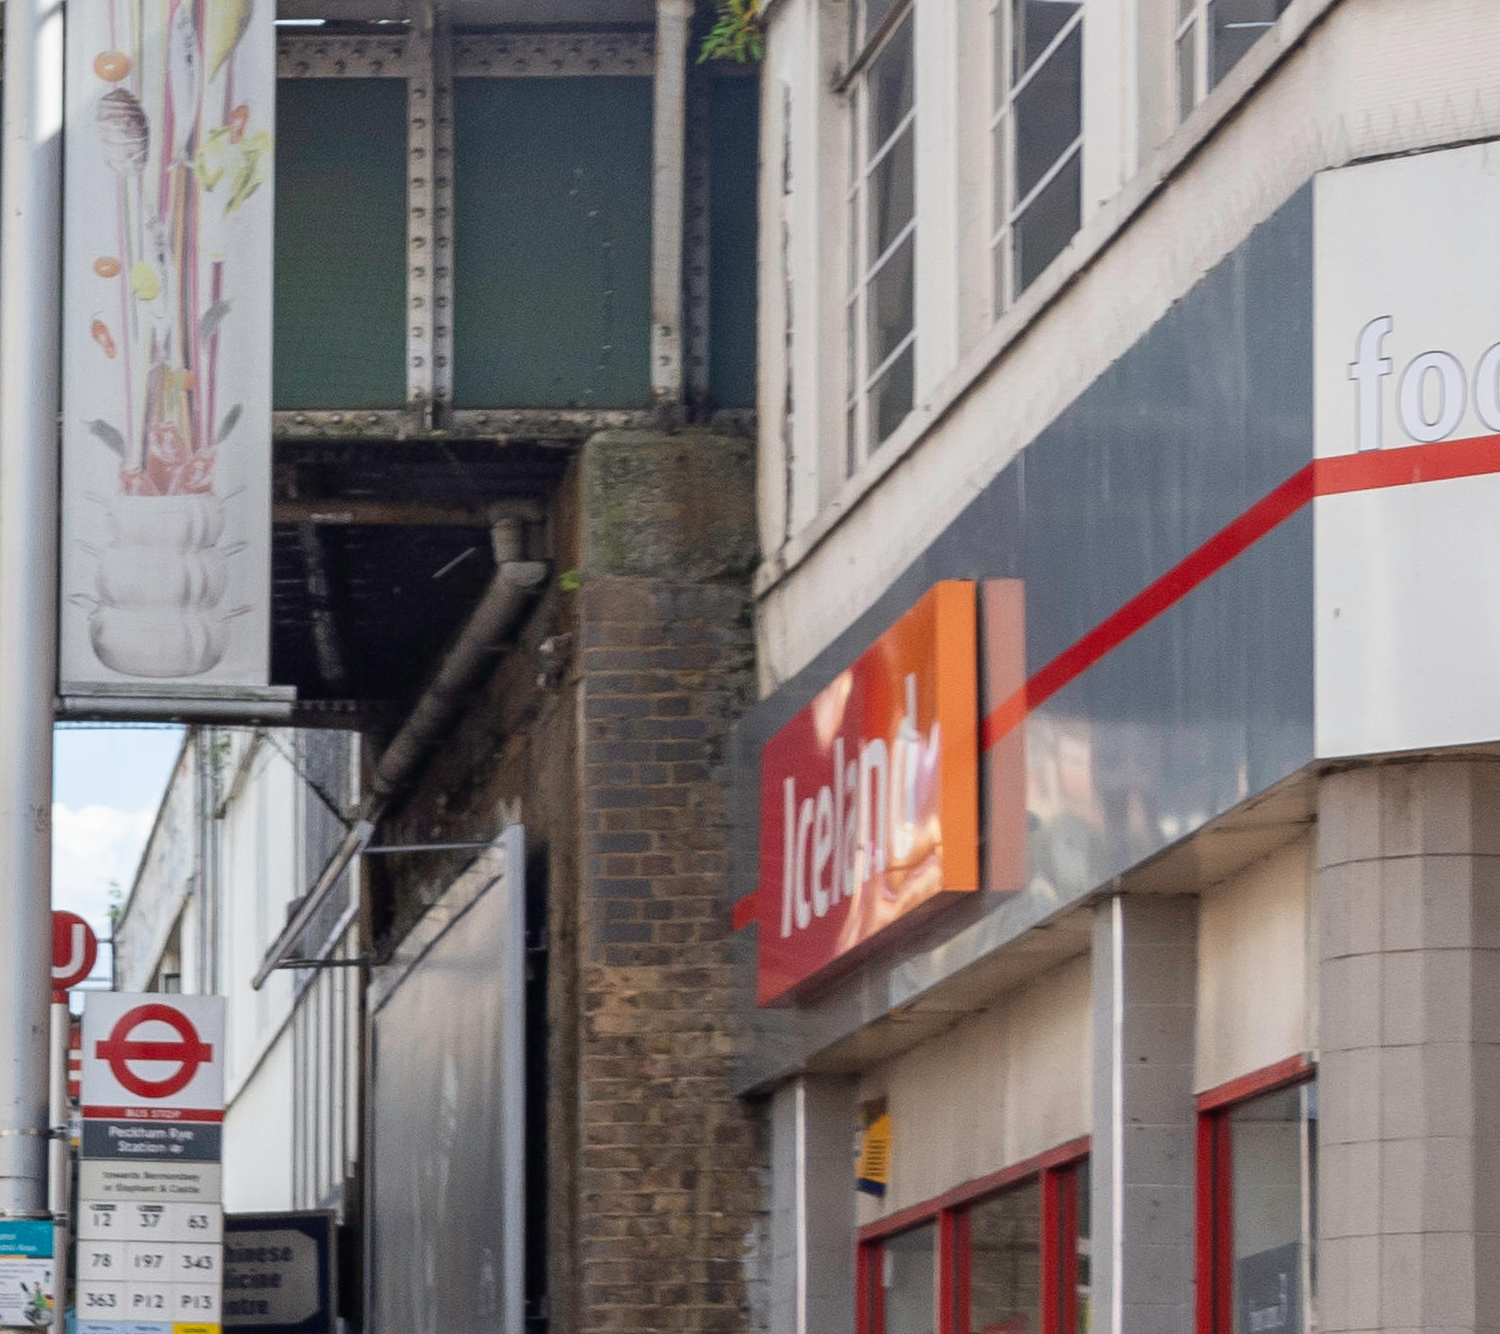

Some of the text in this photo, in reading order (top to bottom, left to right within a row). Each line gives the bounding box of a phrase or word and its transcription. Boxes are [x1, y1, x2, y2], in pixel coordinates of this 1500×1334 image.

[781, 674, 918, 937] Iceland
[124, 1108, 149, 1118] BUS
[108, 1125, 167, 1138] Peckham
[93, 1213, 112, 1227] 12
[140, 1213, 161, 1228] 37
[92, 1253, 213, 1269] 78 197 343
[86, 1293, 213, 1310] 363 P12 P13
